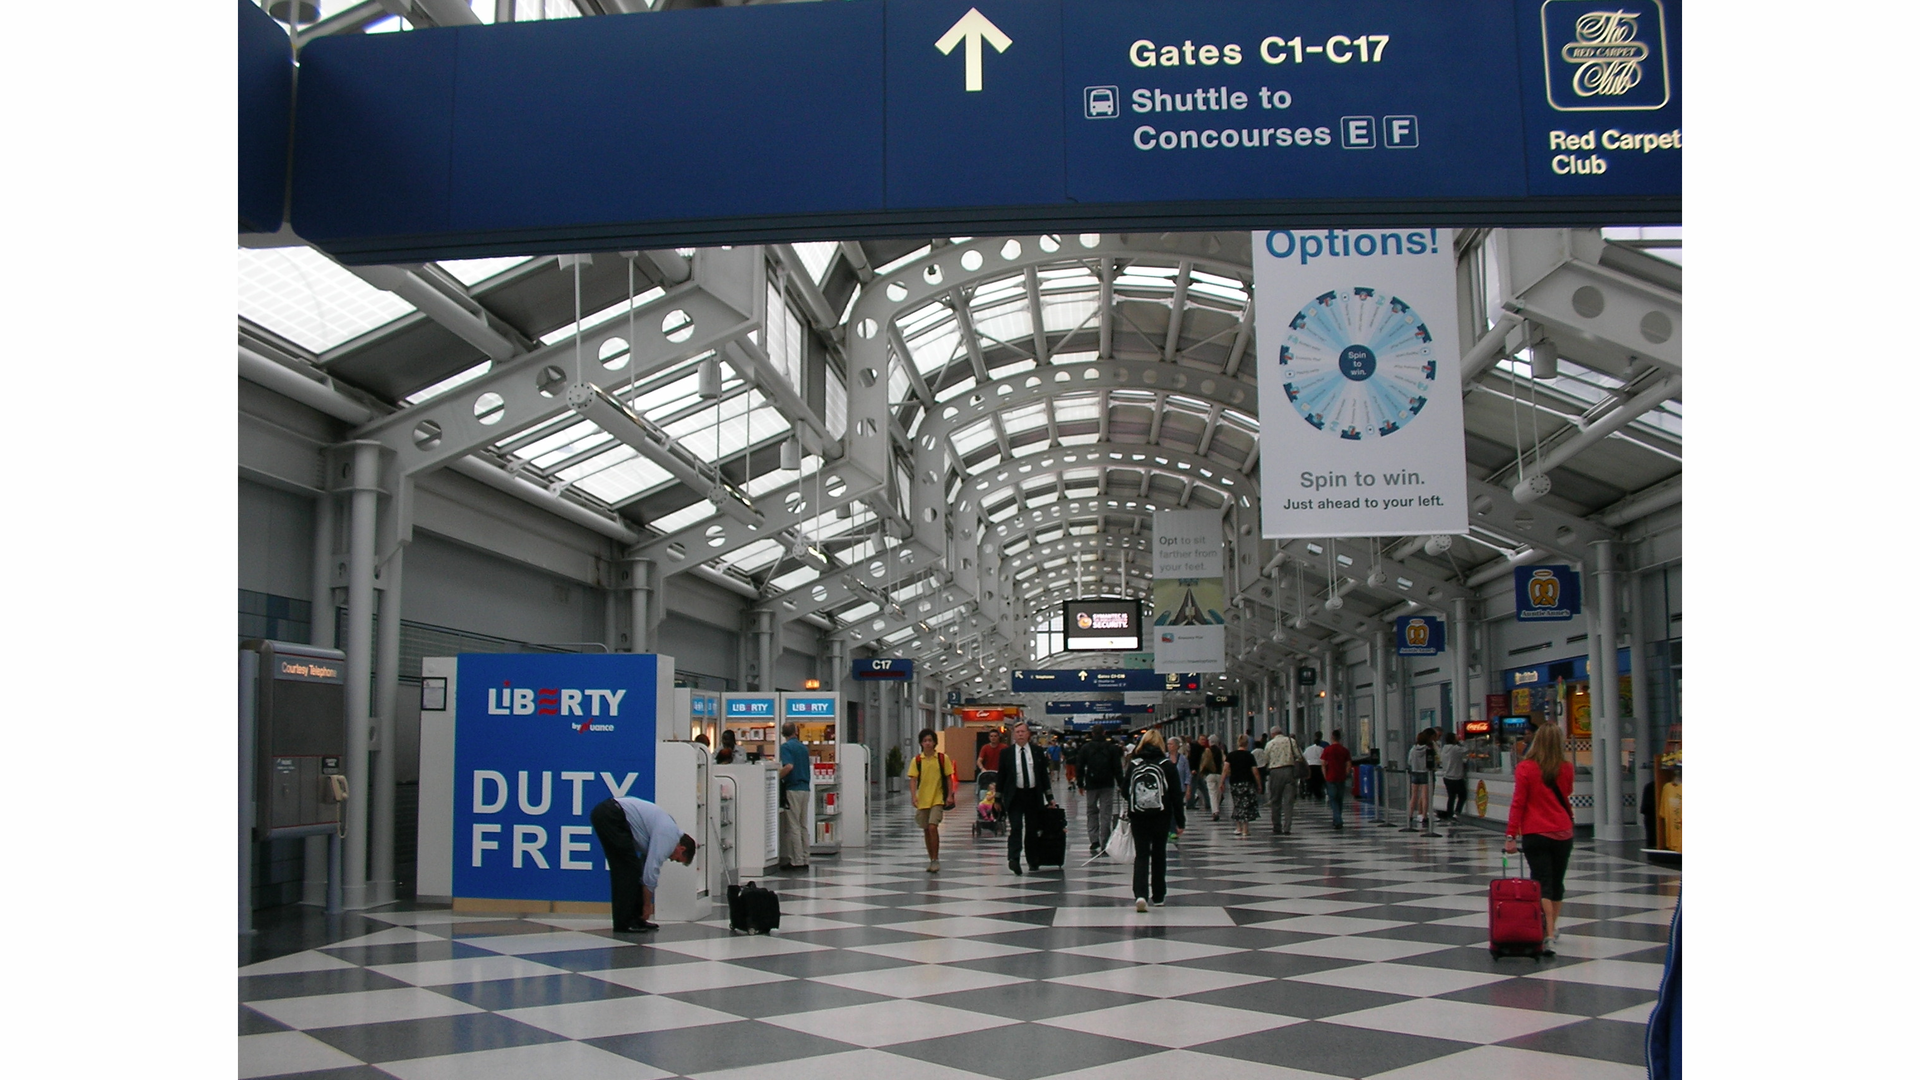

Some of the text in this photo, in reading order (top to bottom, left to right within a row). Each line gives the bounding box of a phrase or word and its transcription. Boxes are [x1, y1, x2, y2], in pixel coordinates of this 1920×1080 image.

[1129, 35, 1390, 67] Gates C1-C17
[1573, 47, 1638, 58] RED CARPET
[1572, 61, 1642, 97] Club
[1131, 86, 1292, 113] Shuttle to
[1133, 120, 1410, 150] Concourses E F
[1550, 129, 1682, 153] Red Carpet
[1552, 154, 1607, 174] Club
[1266, 229, 1439, 265] Options!
[1348, 351, 1367, 361] Spin
[1300, 469, 1425, 491] Spin to win.
[1283, 495, 1444, 512] Just ahead to your left.
[1159, 535, 1206, 546] Opt to sit
[1159, 549, 1217, 559] farther from
[1159, 563, 1182, 573] your
[1521, 609, 1545, 618] Auntie
[281, 661, 338, 678] Courtesy Telephone
[872, 660, 892, 670] C17
[572, 722, 581, 731] by
[472, 770, 639, 816] DUTY
[471, 823, 611, 870] FRE
